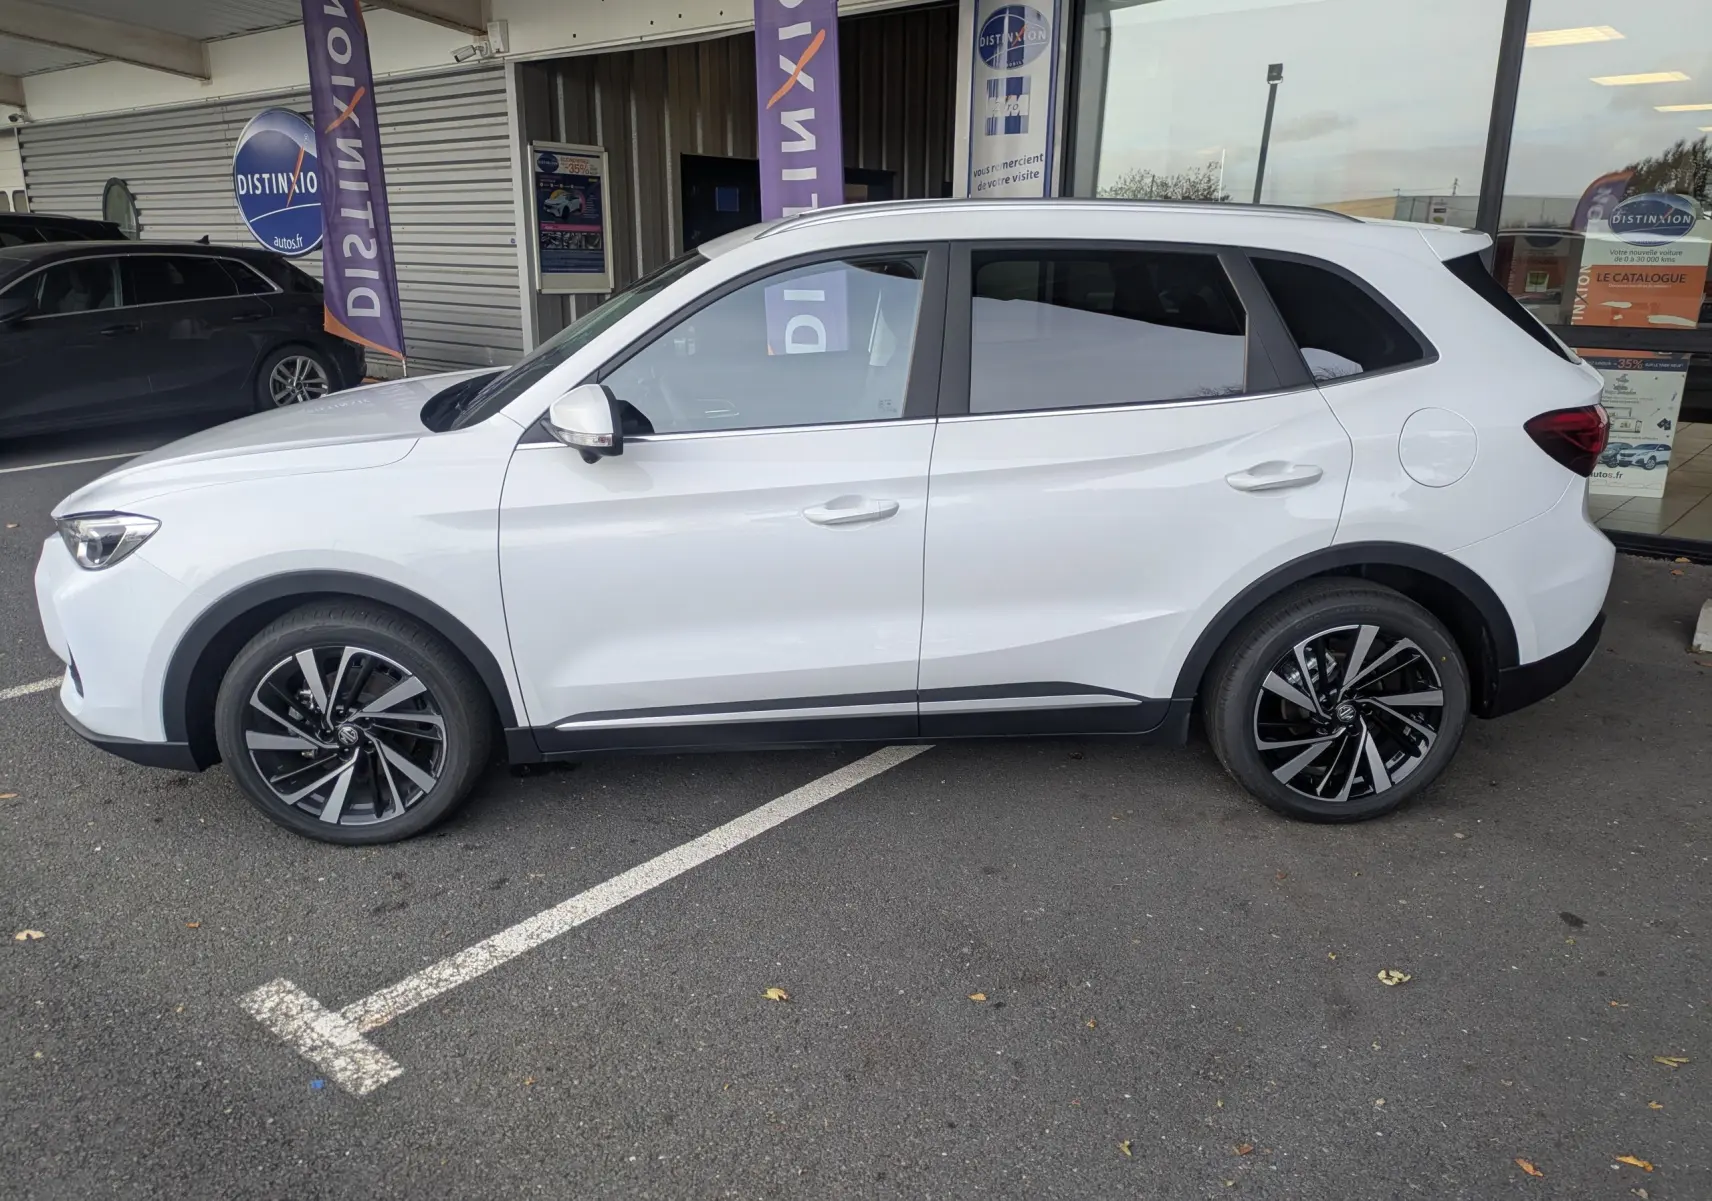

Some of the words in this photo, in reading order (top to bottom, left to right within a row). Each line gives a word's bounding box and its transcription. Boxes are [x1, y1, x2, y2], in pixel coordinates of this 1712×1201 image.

[973, 166, 990, 178] vous
[977, 180, 987, 191] de
[987, 176, 1011, 189] votre
[1012, 169, 1040, 183] visite
[237, 171, 318, 195] DISTINXIO
[1612, 215, 1692, 224] DISTINXION
[273, 233, 303, 249] autos.fr
[1659, 249, 1683, 257] voiture
[1596, 272, 1611, 282] LE
[1612, 272, 1688, 283] CATALOGUE
[1571, 265, 1592, 325] INXION
[339, 727, 358, 745] MG
